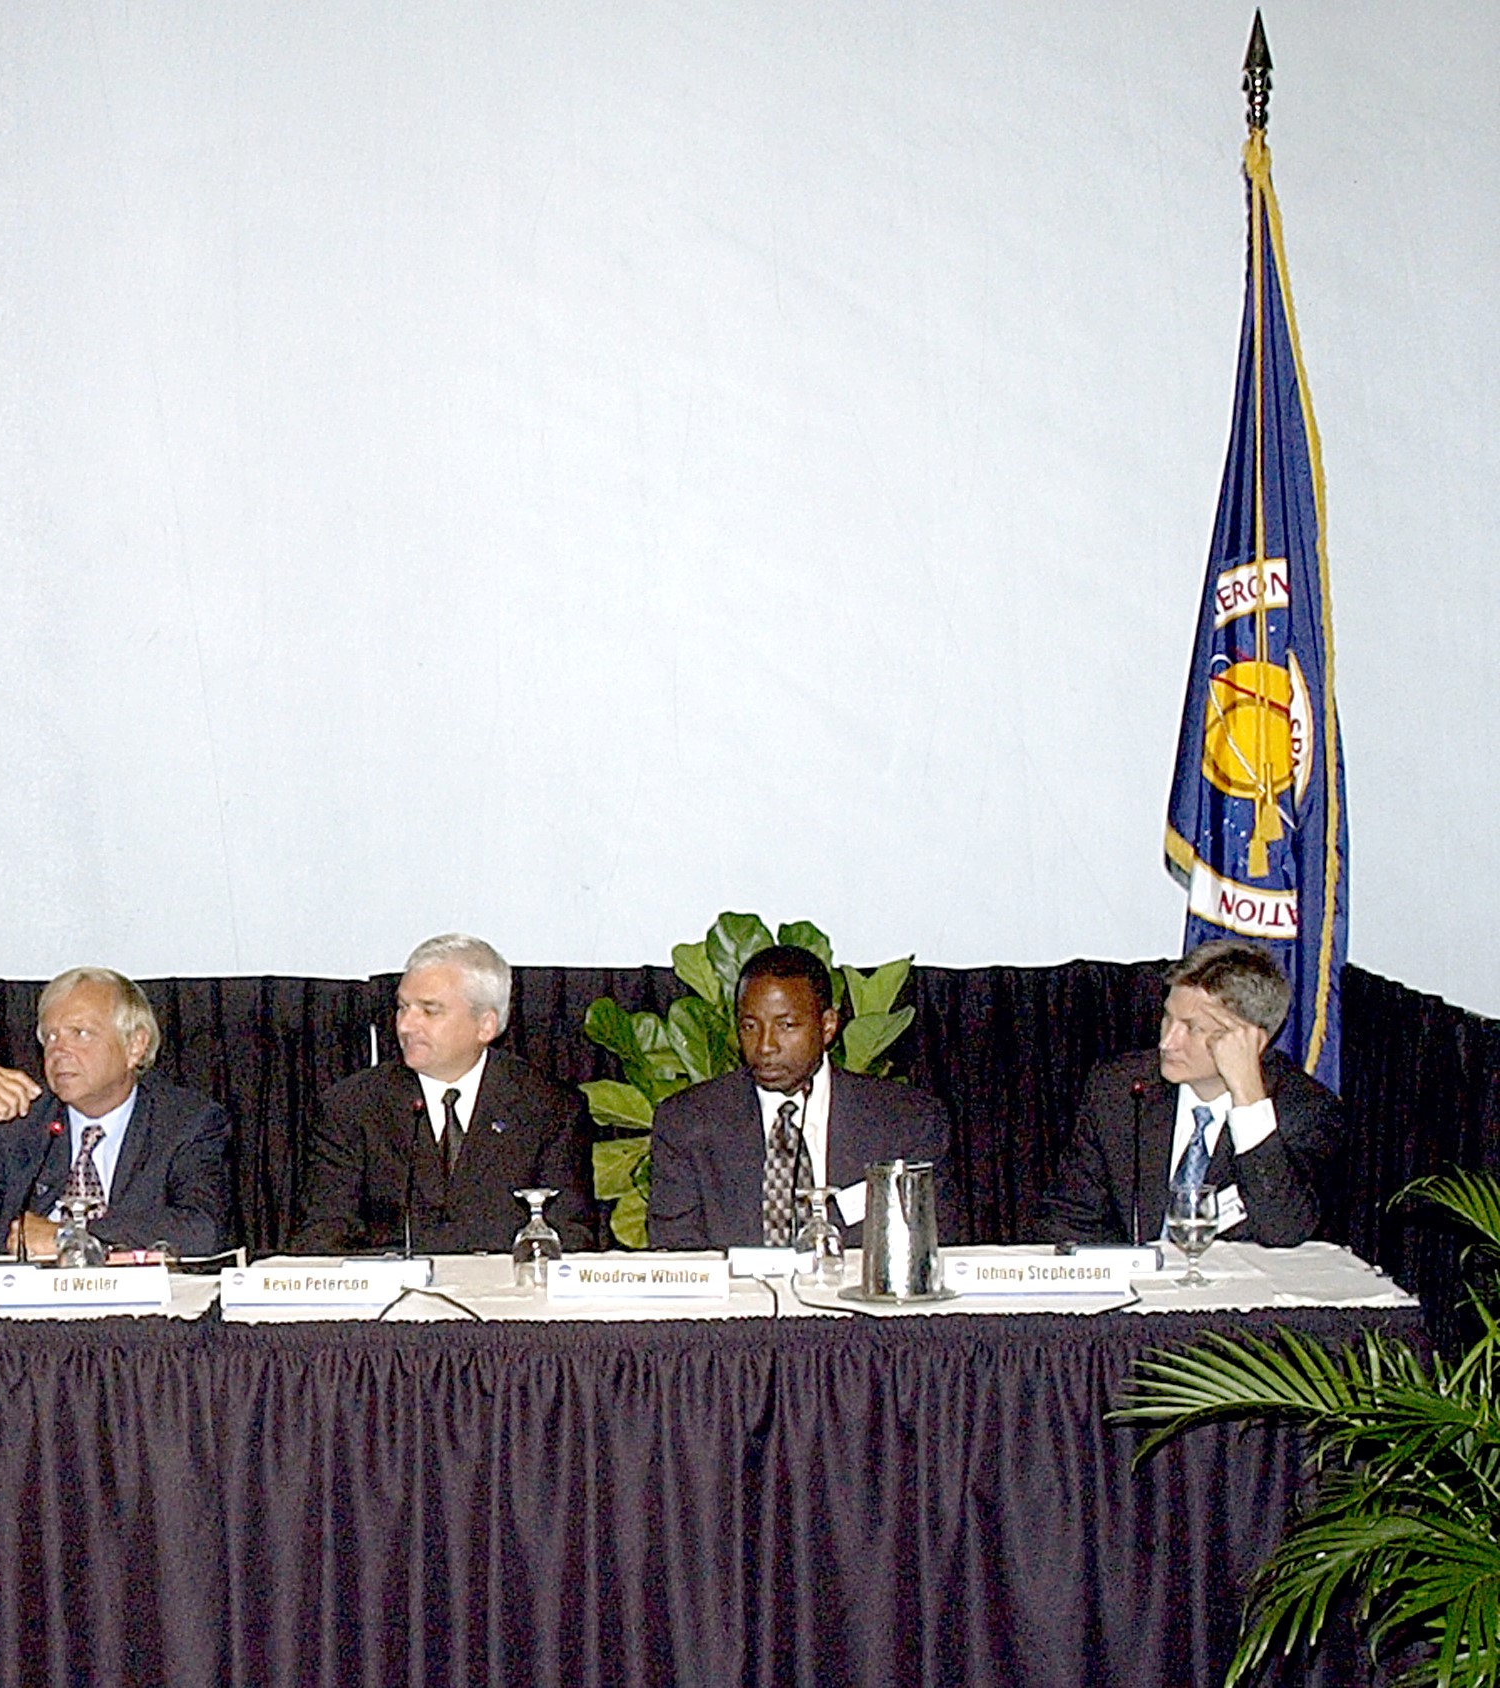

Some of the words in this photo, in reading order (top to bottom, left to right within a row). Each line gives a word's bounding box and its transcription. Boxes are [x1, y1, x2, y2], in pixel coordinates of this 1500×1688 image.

[53, 1277, 69, 1292] Ed
[73, 1276, 119, 1291] Weiler
[263, 1277, 301, 1291] Kevin
[305, 1276, 369, 1290] Peterson
[579, 1269, 647, 1284] Woodrow
